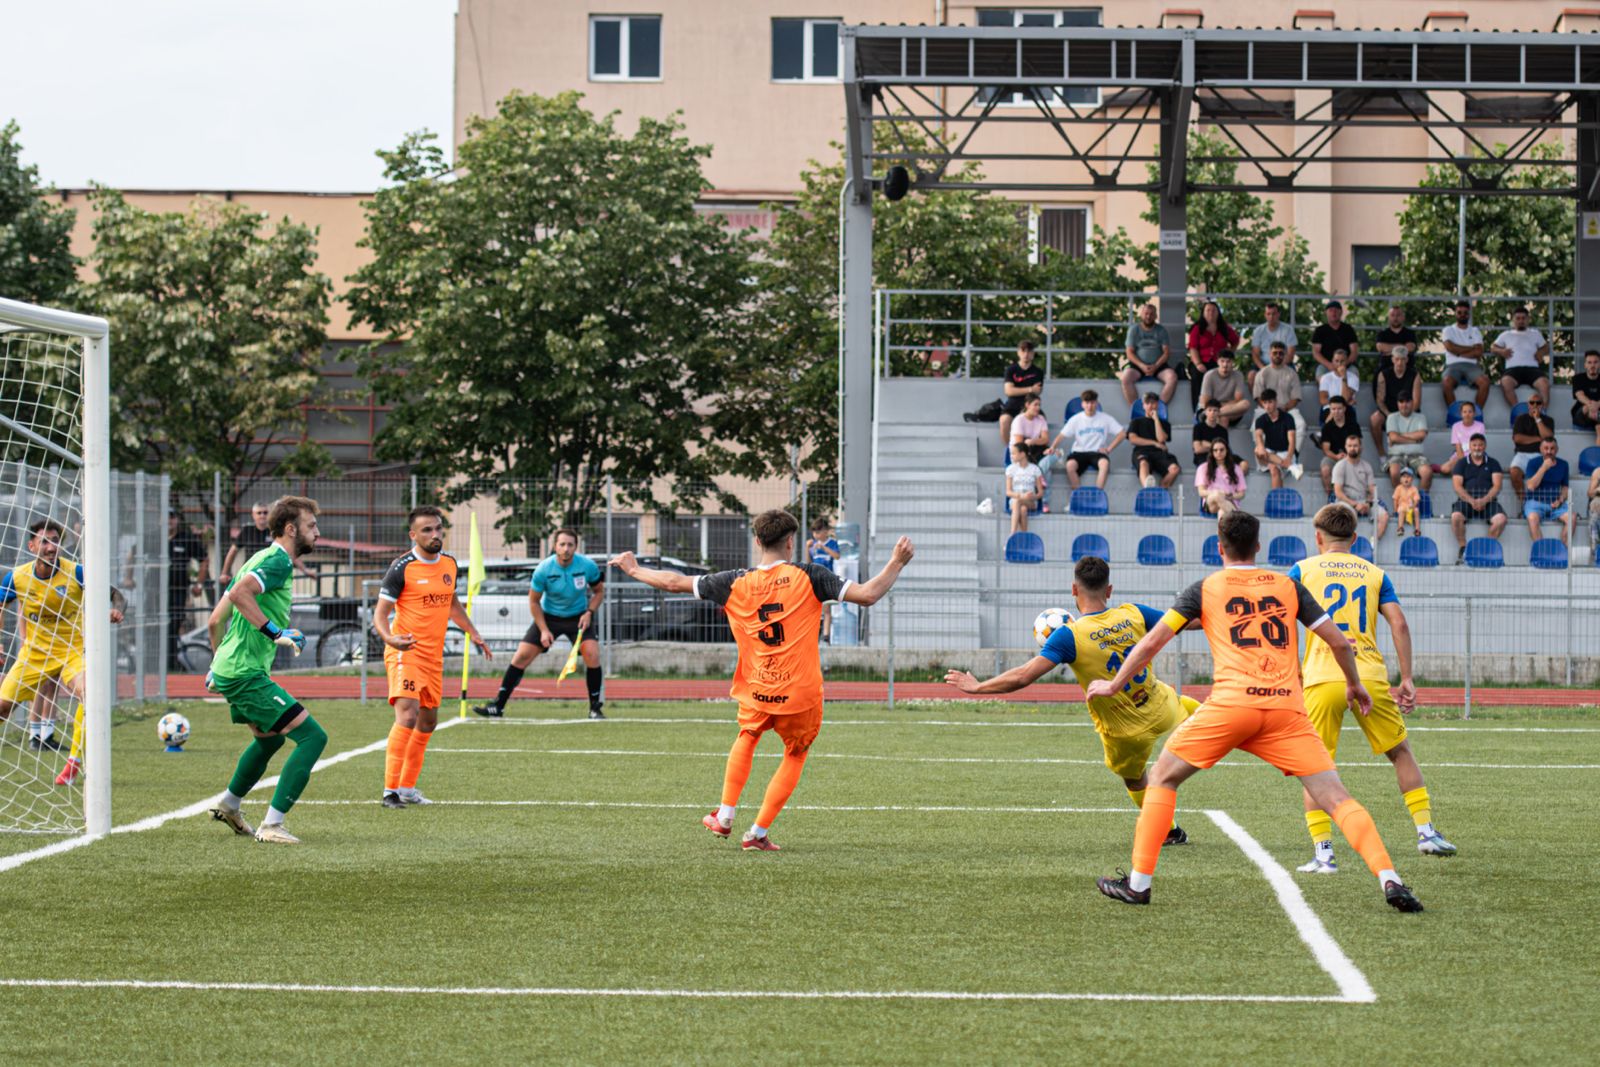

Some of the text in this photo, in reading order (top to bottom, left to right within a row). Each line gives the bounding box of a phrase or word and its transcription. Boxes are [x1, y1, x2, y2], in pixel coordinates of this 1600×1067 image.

[1319, 561, 1370, 573] CORONA
[1325, 570, 1366, 580] BRASOV
[1323, 583, 1367, 634] 21
[758, 602, 785, 647] 5
[1089, 619, 1133, 641] CORONA
[1098, 631, 1134, 650] BRASOV
